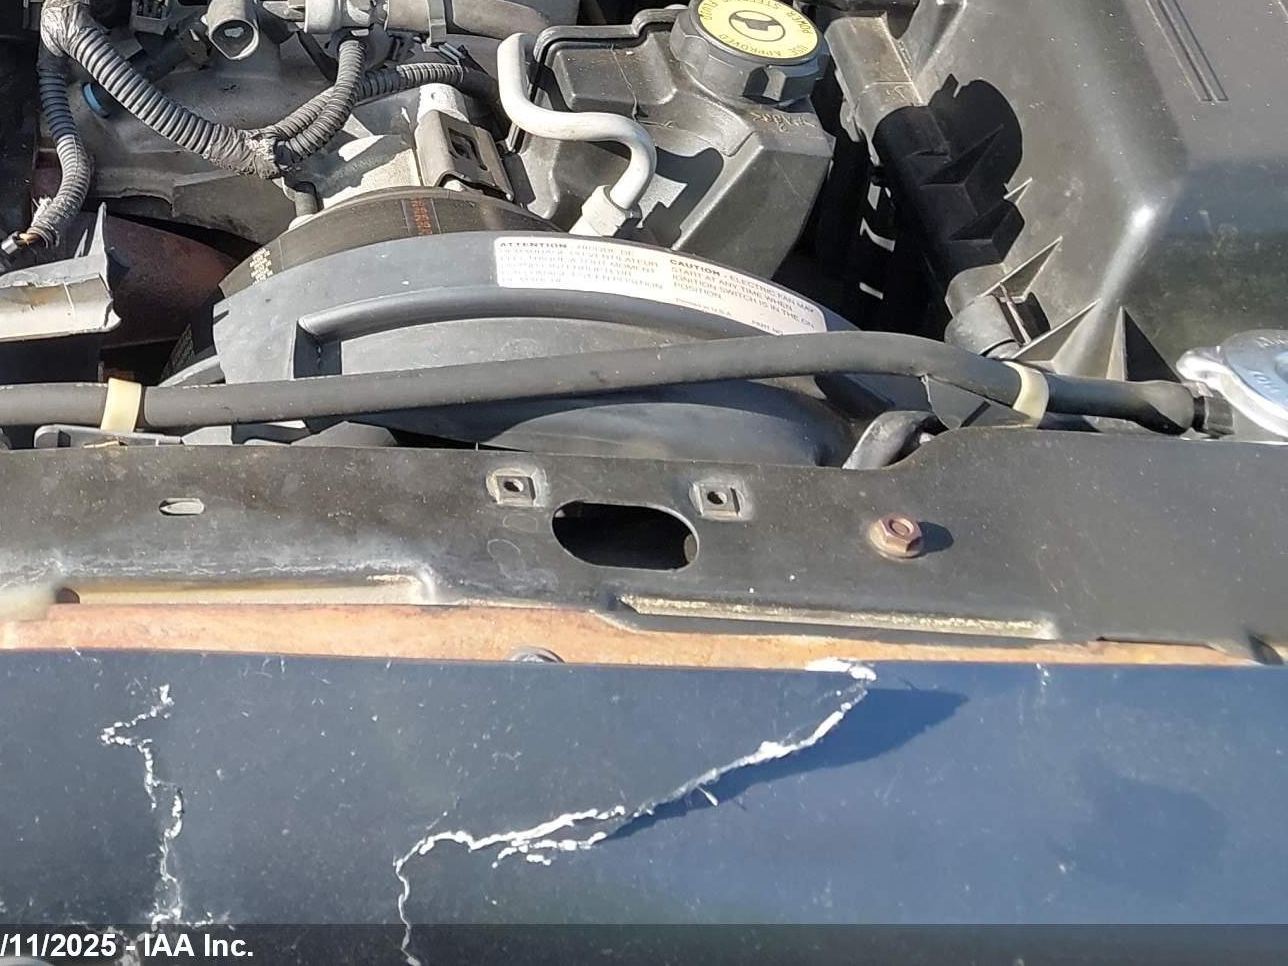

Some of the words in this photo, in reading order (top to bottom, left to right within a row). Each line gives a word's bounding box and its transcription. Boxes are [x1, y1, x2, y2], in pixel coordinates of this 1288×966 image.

[787, 11, 814, 35] POWER
[718, 33, 782, 56] APPROVED
[787, 44, 809, 56] USE
[670, 259, 721, 276] CAUTION
[729, 275, 776, 296] ELECTRIC
[797, 300, 815, 313] MAY
[671, 266, 701, 278] START
[741, 284, 762, 297] TIME
[765, 293, 793, 311] WHEN
[672, 274, 717, 291] IGNITION
[719, 286, 757, 303] SWITCH
